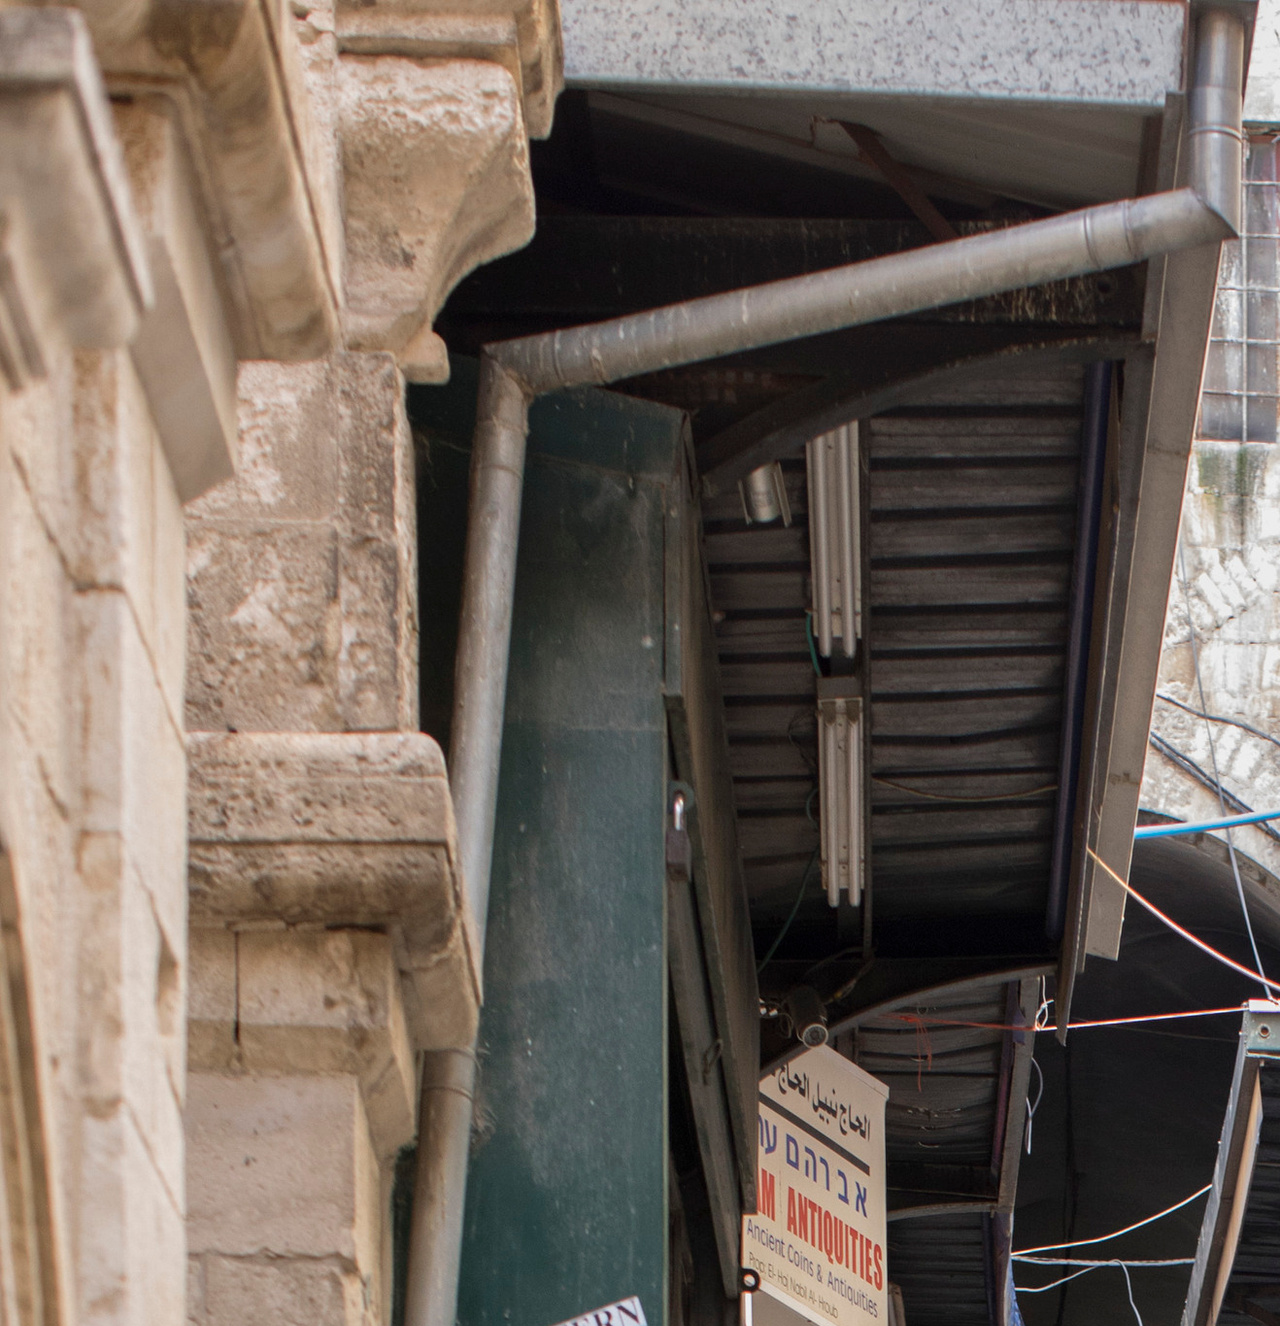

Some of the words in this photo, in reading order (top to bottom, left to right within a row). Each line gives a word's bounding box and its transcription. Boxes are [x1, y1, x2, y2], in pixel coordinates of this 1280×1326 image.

[812, 1081, 838, 1125] نبيل
[839, 1103, 870, 1141] الحاج
[786, 1133, 868, 1218] אברהם
[747, 1218, 785, 1258] Ancient
[787, 1244, 814, 1277] Coins
[816, 1264, 823, 1284] &
[827, 1271, 878, 1318] Antiquities
[787, 1186, 883, 1291] ANTIQUITIES
[790, 1277, 808, 1298] Nabil
